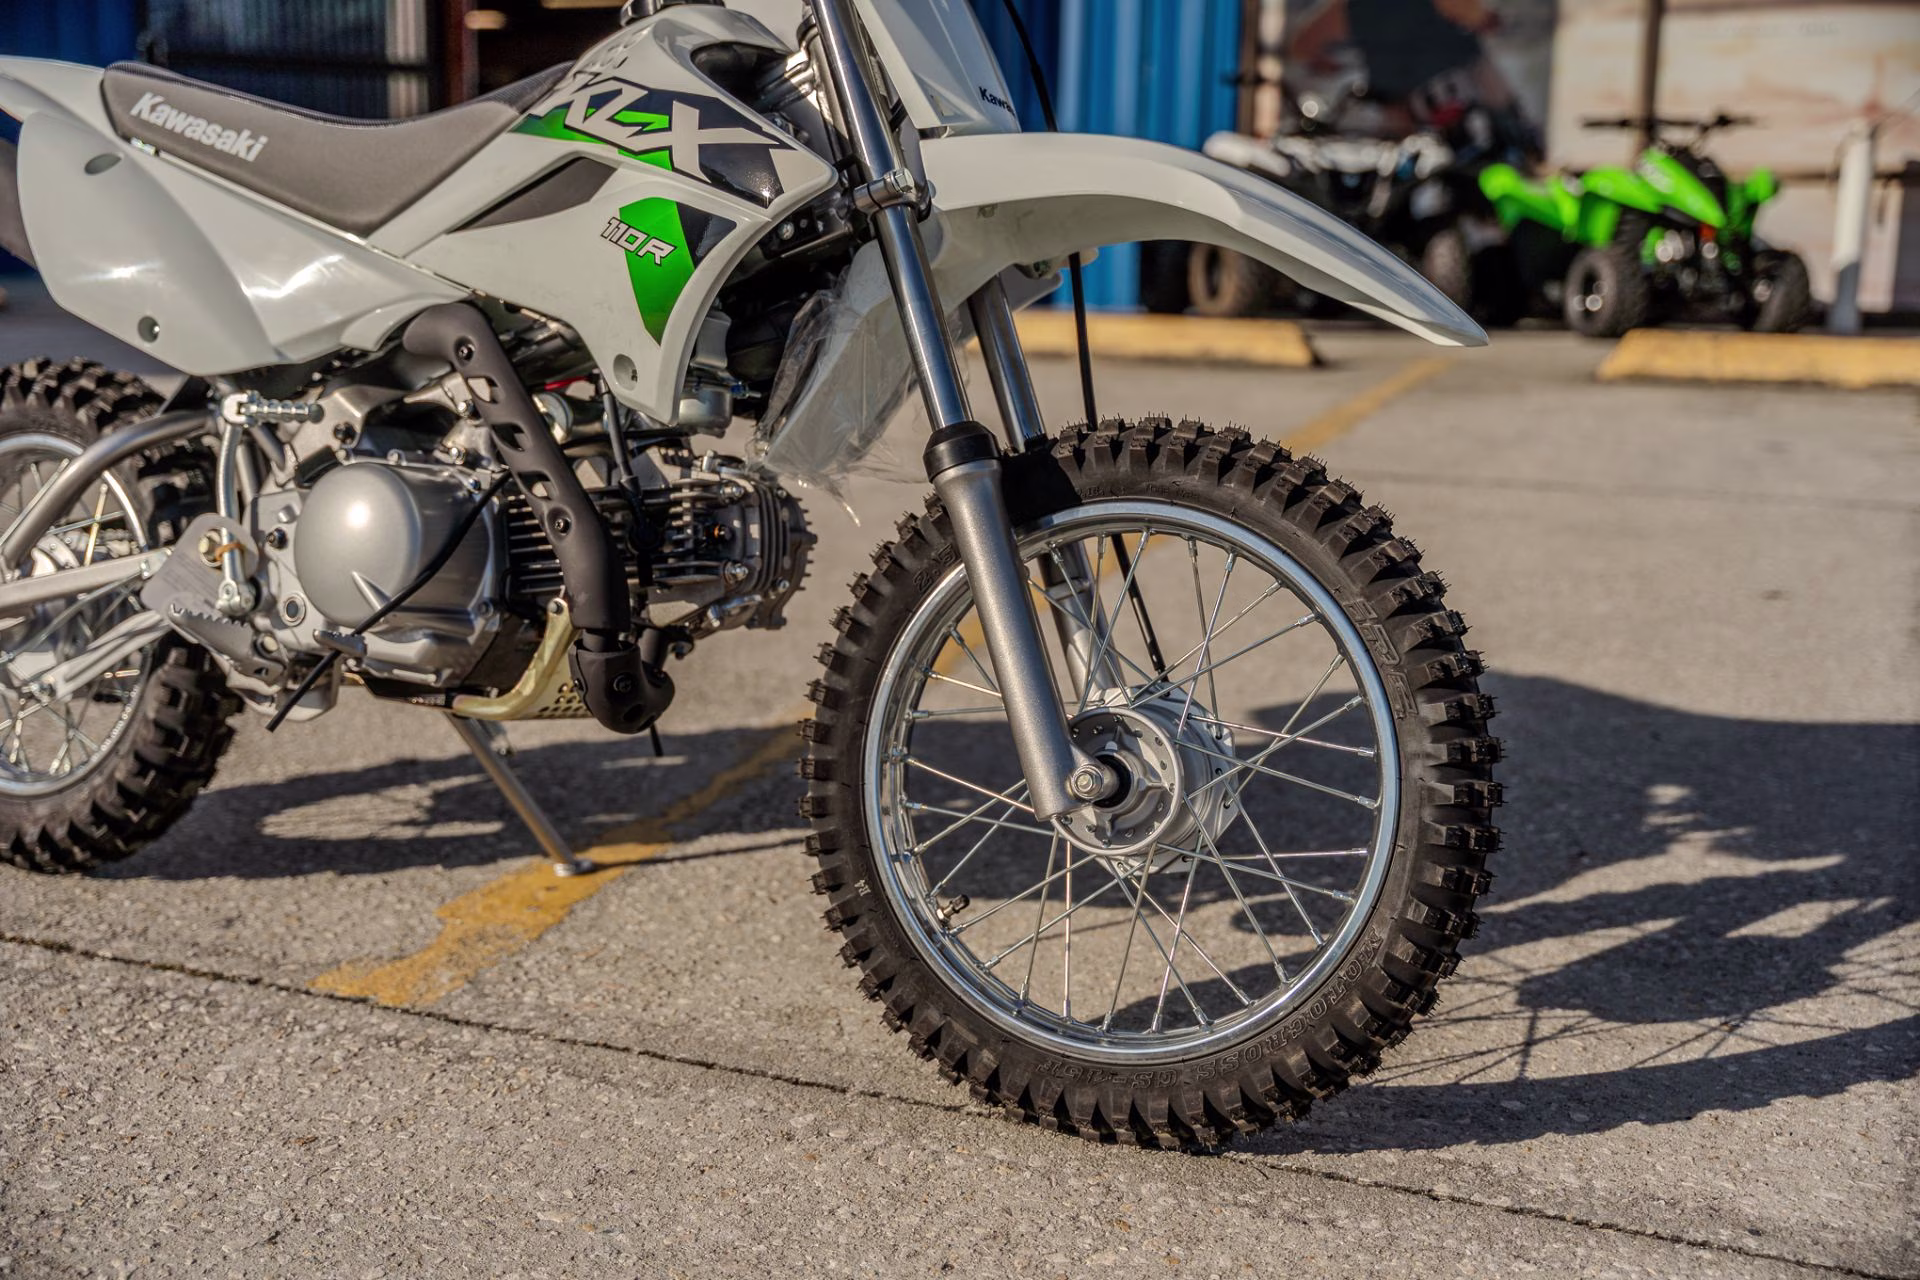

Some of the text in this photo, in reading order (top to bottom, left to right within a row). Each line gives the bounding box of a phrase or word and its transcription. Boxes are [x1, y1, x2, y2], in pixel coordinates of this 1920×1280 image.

[130, 91, 269, 162] Kawasaki
[978, 86, 1016, 118] Kawa
[600, 216, 678, 267] 110R
[913, 543, 957, 594] 2.5
[1196, 926, 1384, 1081] MOTOCROSS
